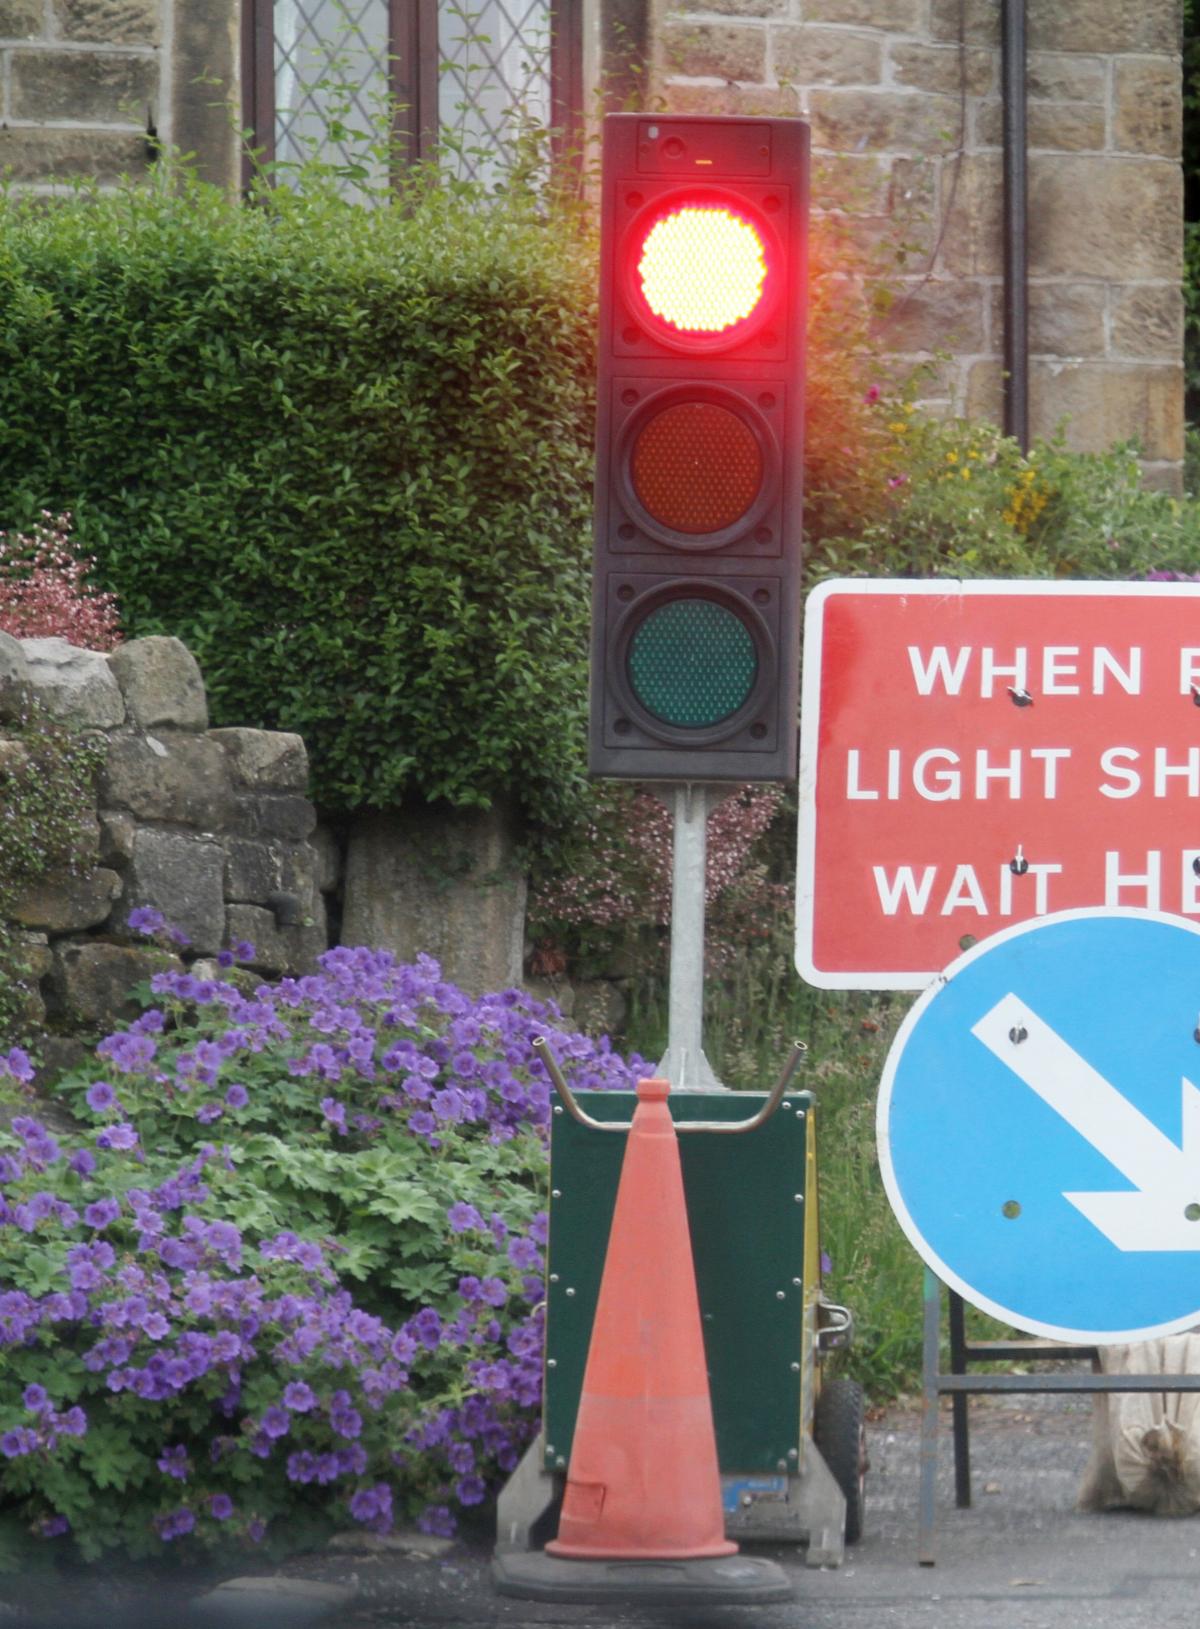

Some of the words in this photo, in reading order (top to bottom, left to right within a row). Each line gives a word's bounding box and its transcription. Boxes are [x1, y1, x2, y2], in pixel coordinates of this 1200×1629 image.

[907, 645, 1143, 699] WHEN
[846, 747, 1073, 801] LIGHT
[872, 862, 1063, 916] WAIT
